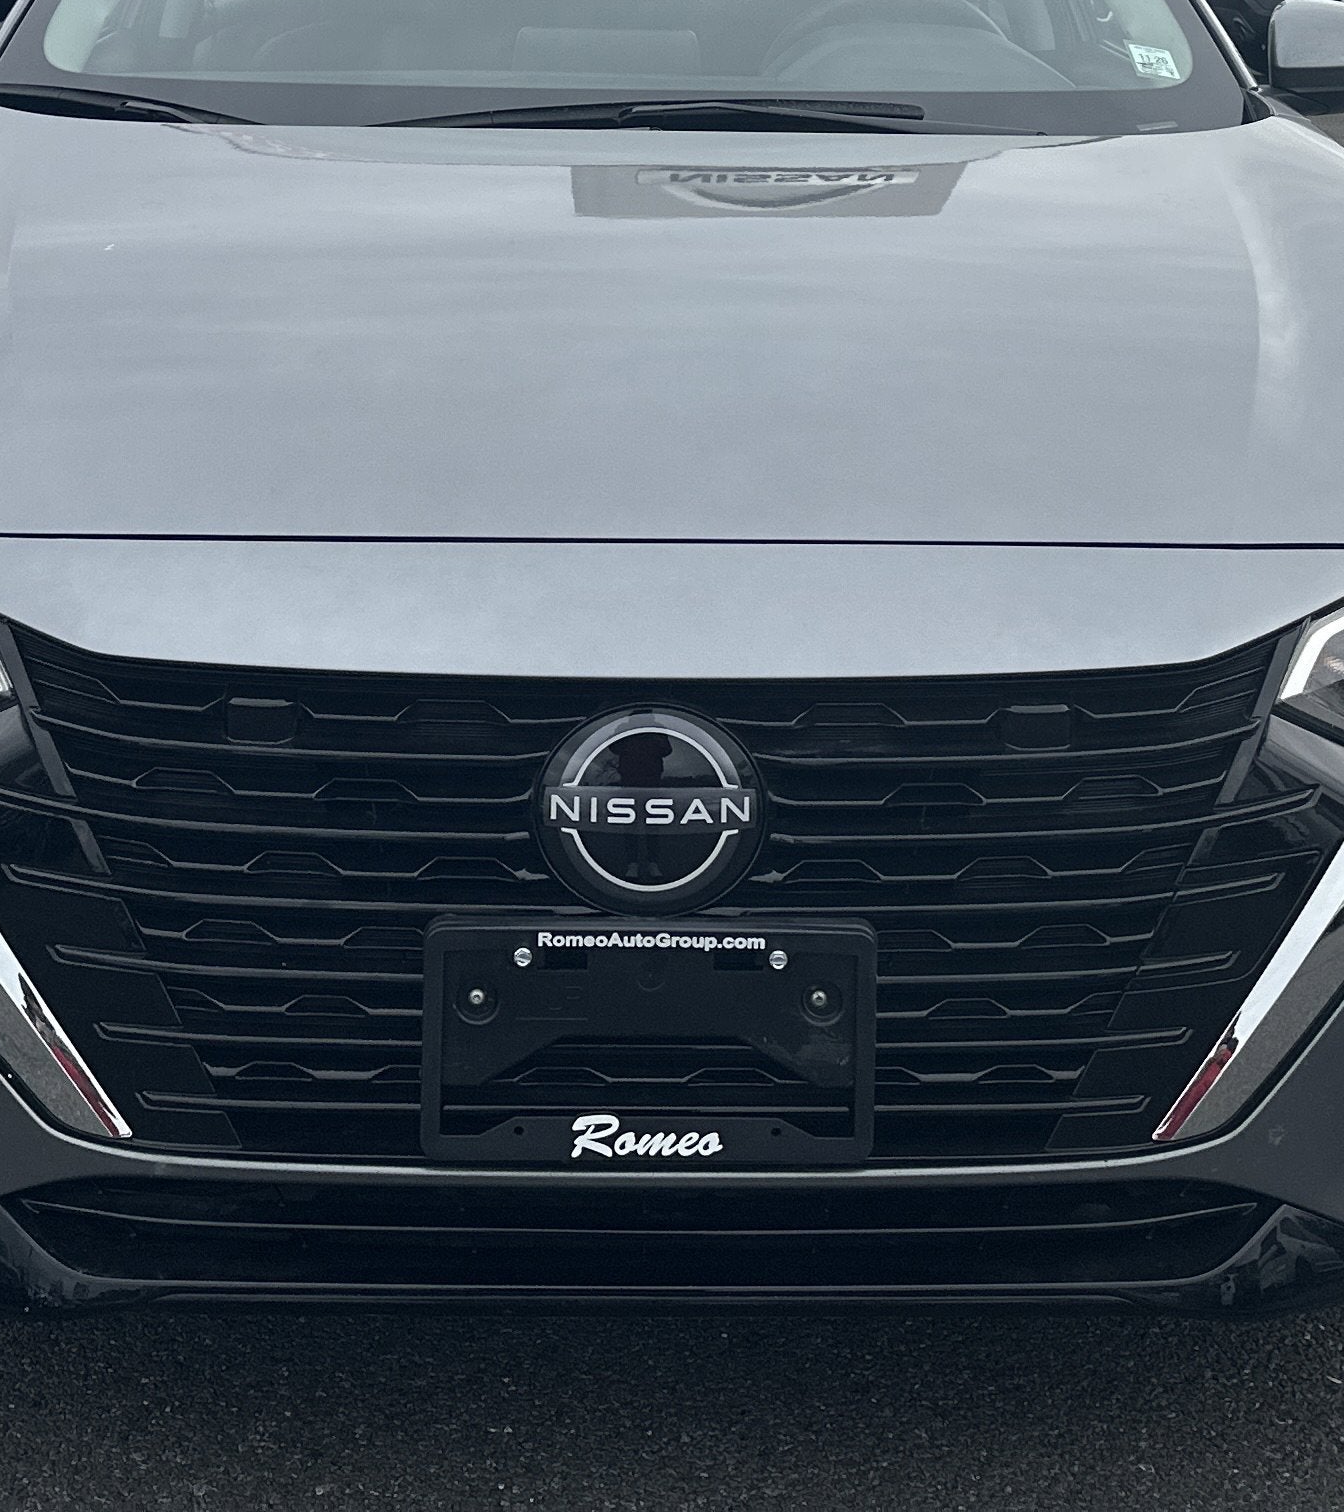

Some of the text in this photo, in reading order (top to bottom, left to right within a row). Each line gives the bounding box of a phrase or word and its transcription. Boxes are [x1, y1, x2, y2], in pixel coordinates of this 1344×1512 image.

[549, 794, 751, 825] NISSAN
[537, 931, 766, 952] RomeoAutoGroup.com
[570, 1114, 724, 1158] Romeo
